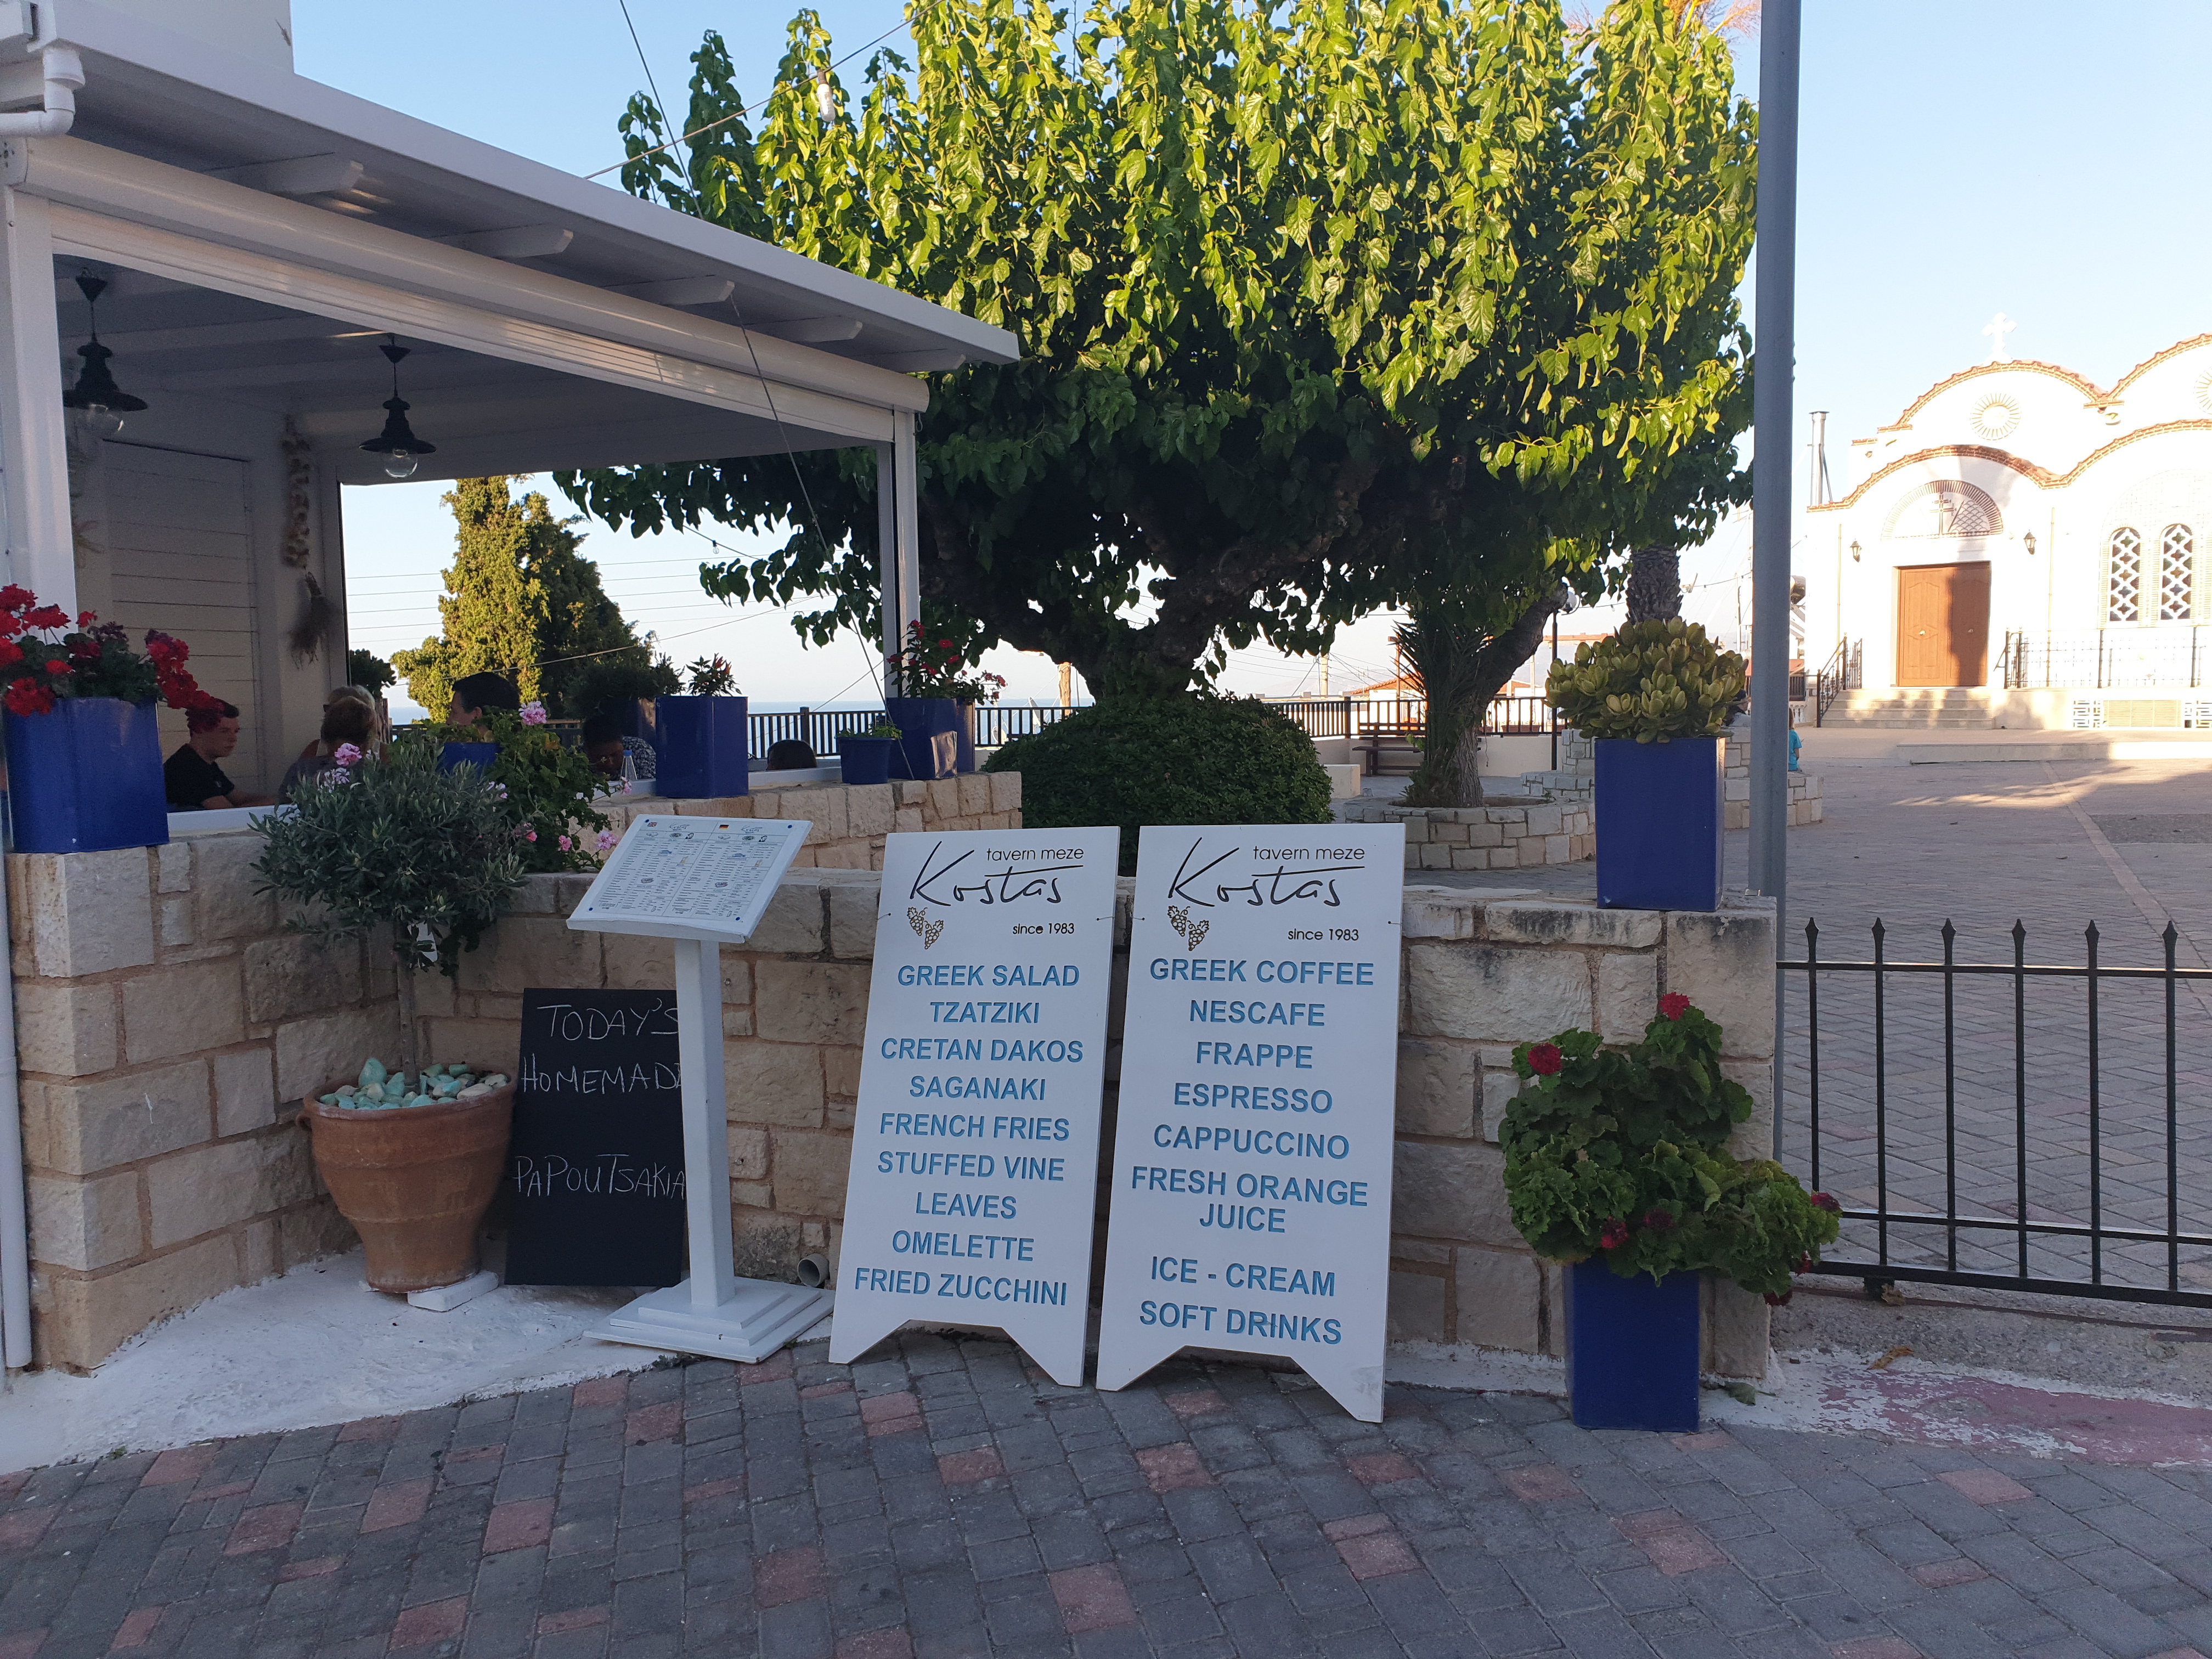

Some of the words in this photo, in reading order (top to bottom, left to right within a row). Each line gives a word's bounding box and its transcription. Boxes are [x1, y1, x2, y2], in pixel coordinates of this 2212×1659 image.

[986, 848, 1036, 861] tavern
[1041, 848, 1084, 860] meze
[1252, 845, 1310, 860] tavern
[1316, 848, 1365, 860] meze
[909, 840, 1084, 907] Kostas
[1167, 837, 1365, 907] Kostas
[1012, 923, 1043, 935] since
[1048, 922, 1075, 934] 1983
[1288, 928, 1323, 940] since
[1329, 928, 1359, 941] 1983
[898, 965, 985, 986] GREEK
[992, 964, 1080, 986] SALAD
[1150, 958, 1247, 982] GREEK
[1256, 960, 1374, 986] COFFEE
[930, 1002, 1040, 1024] TZATZIKI
[1189, 1000, 1325, 1026] NESCAFE
[881, 1037, 982, 1060] CRETAN
[990, 1039, 1083, 1063] DAKOS
[1197, 1041, 1313, 1069] FRAPPE
[910, 1075, 1046, 1101] SAGANAKI
[1174, 1082, 1333, 1114] ESPRESSO
[880, 1113, 985, 1138] FRENCH
[993, 1116, 1069, 1141] FRIES
[1154, 1124, 1350, 1160] CAPPUCCINO
[512, 1153, 686, 1200] PAPOUTSAKIA
[878, 1150, 995, 1177] STUFFED
[1004, 1156, 1065, 1181] VINE
[1132, 1166, 1226, 1195] FRESH
[1237, 1173, 1368, 1206] ORANGE
[916, 1192, 1017, 1220] LEAVES
[1199, 1203, 1286, 1233] JUICE
[892, 1230, 1034, 1262] OMELETTE
[855, 1267, 930, 1295] FRIED
[937, 1273, 1067, 1306] ZUCCHINI
[1151, 1256, 1198, 1284] ICE
[1226, 1262, 1335, 1297] CREAM
[1139, 1300, 1217, 1331] SOFT
[1226, 1308, 1341, 1345] DRINKS
